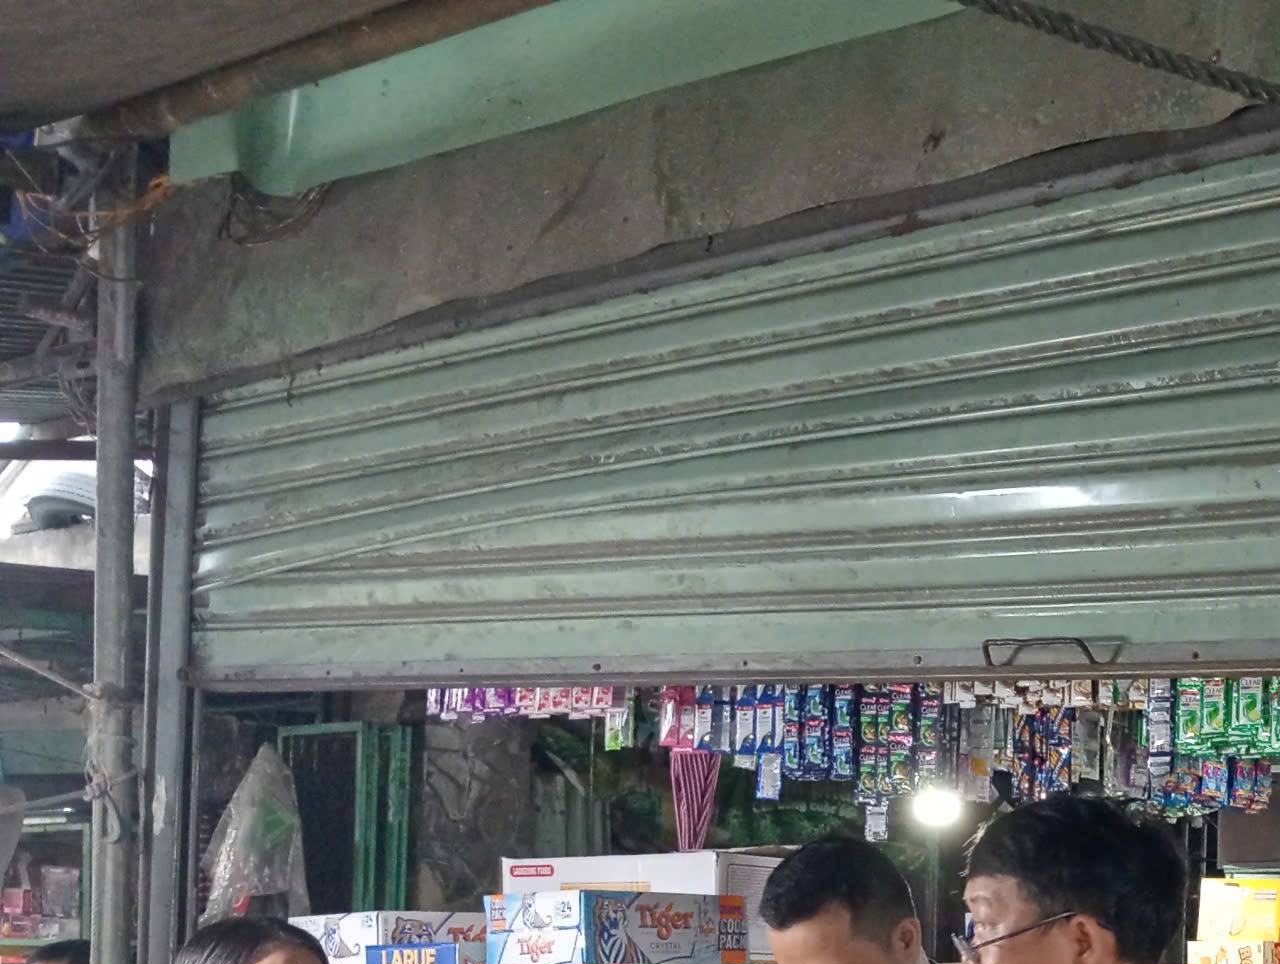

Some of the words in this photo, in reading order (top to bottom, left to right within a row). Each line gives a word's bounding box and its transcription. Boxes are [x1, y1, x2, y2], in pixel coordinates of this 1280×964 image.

[560, 901, 572, 912] 24
[636, 902, 694, 940] Tiger
[720, 919, 748, 933] COOL
[719, 934, 745, 949] PACK
[517, 937, 554, 963] Tiger
